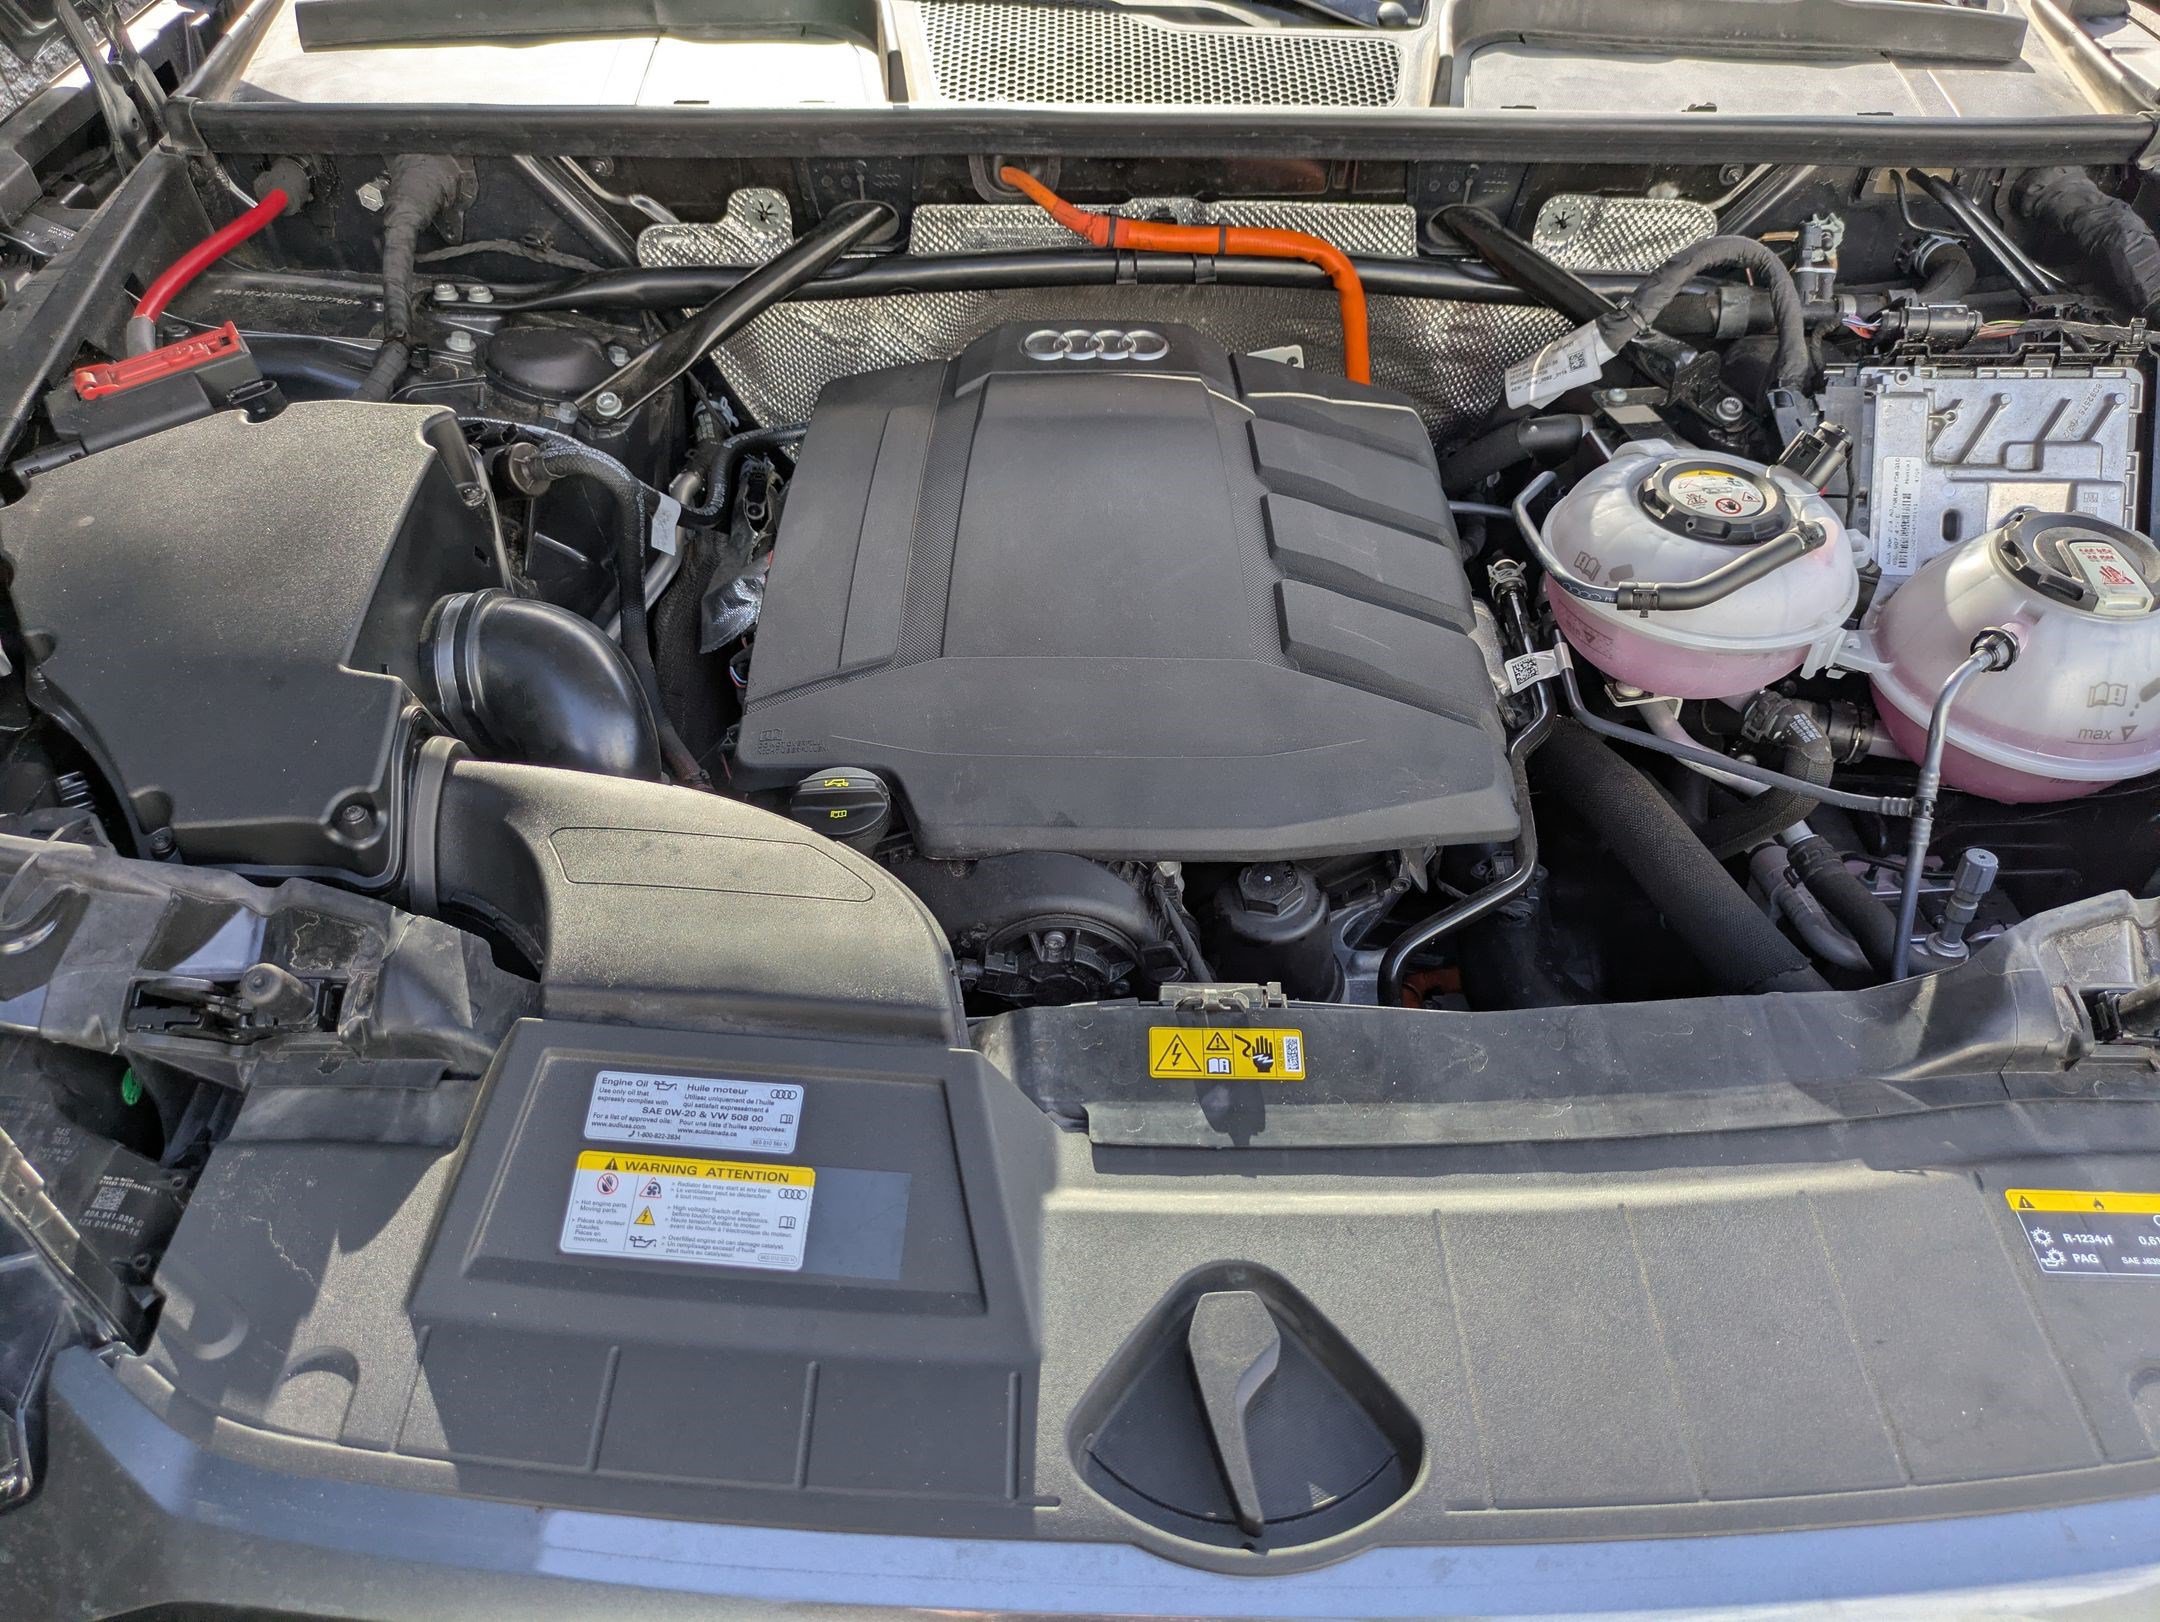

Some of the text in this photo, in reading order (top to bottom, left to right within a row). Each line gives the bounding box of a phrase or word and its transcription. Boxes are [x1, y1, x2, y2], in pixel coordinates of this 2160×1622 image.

[2078, 728, 2112, 740] max
[602, 1077, 633, 1087] Engine
[612, 1088, 626, 1096] only
[687, 1083, 748, 1095] Huile moteur
[597, 1096, 625, 1104] expressly
[627, 1097, 654, 1105] complies
[684, 1093, 707, 1101] Utilisez
[708, 1096, 745, 1104] uniquement
[642, 1106, 662, 1115] SAE
[664, 1108, 696, 1117] 0W-20
[711, 1111, 729, 1120] VW
[731, 1113, 749, 1122] 508
[628, 1115, 658, 1124] approved
[679, 1119, 694, 1127] Pour
[708, 1120, 721, 1128] liste
[591, 1121, 647, 1130] www.audiusa.com
[677, 1128, 737, 1137] www.audicanada.ca
[625, 1161, 790, 1183] WARNING ATTENTION
[2062, 1232, 2114, 1247] R-1234yf
[2072, 1253, 2099, 1264] PAG
[2121, 1256, 2140, 1265] SAE
